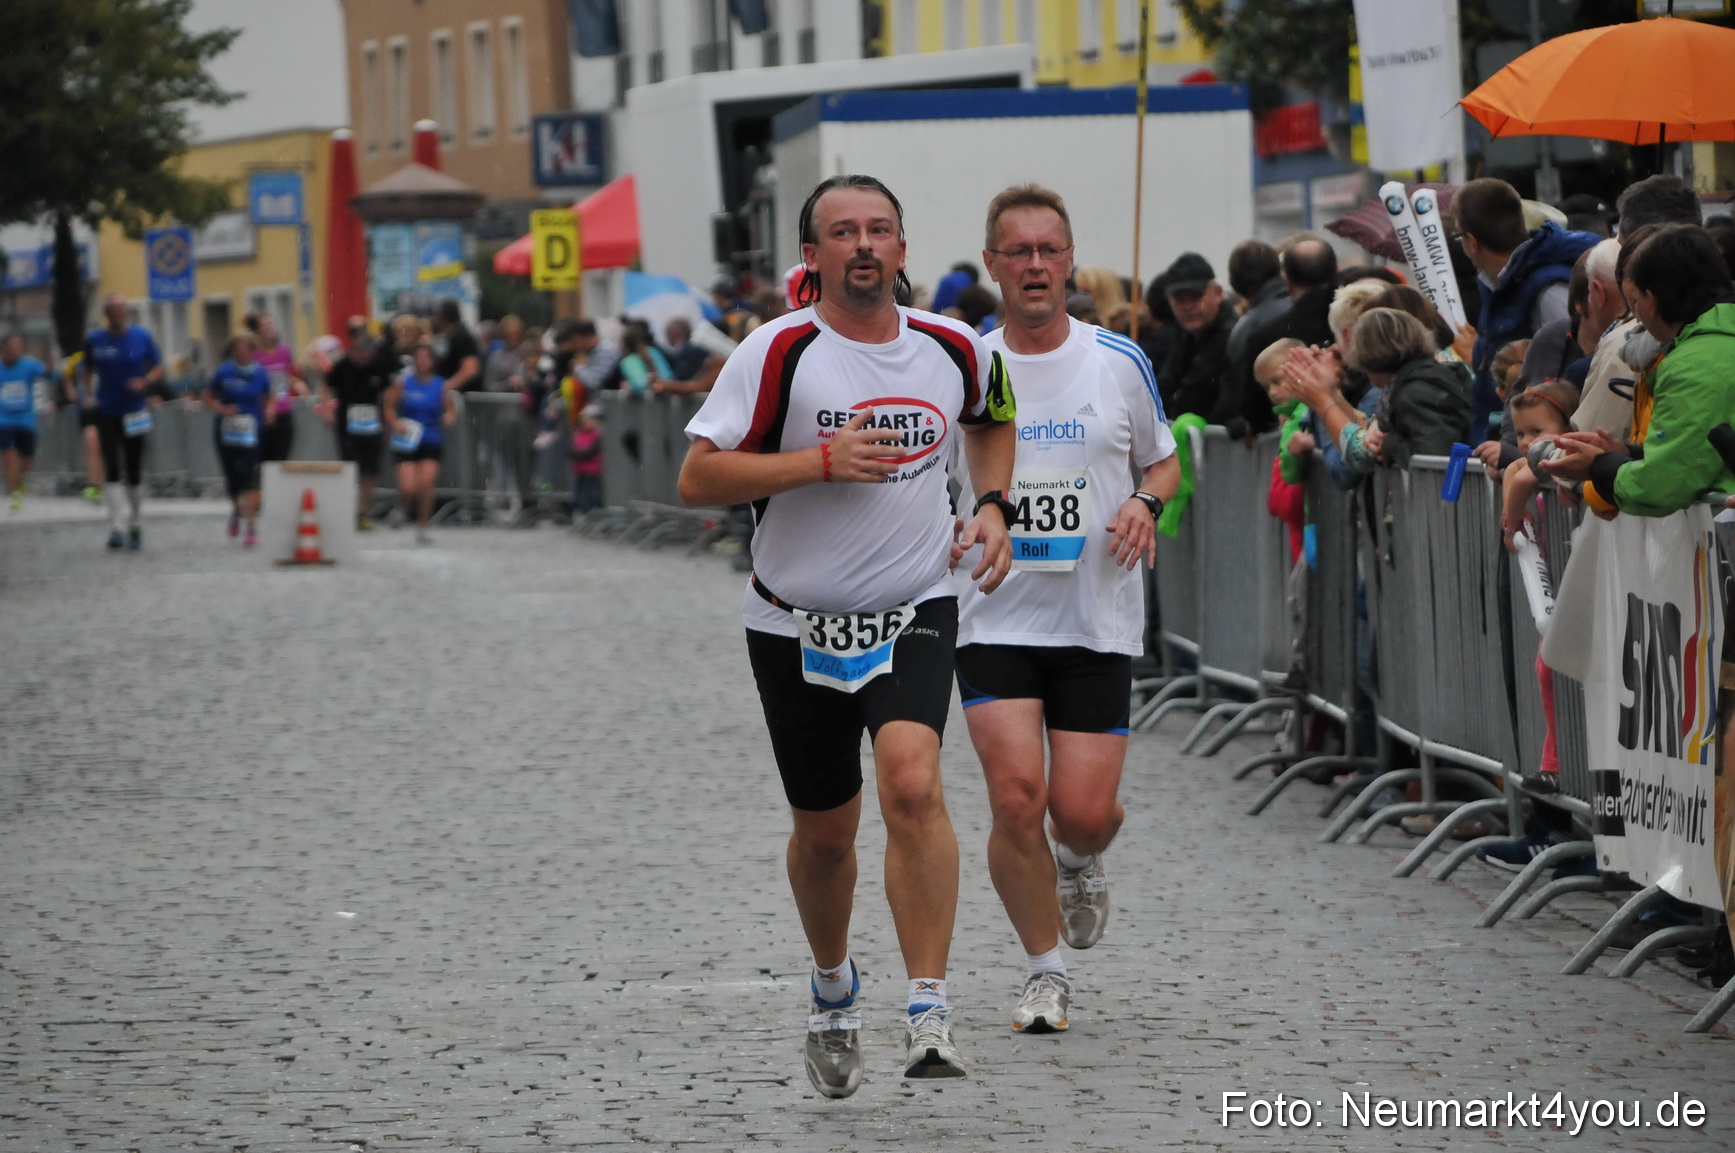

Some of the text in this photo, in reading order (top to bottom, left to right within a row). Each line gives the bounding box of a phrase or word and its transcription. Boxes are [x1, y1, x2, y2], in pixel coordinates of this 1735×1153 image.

[546, 234, 571, 271] D
[816, 409, 934, 430] GEHART &
[1018, 480, 1070, 490] Neumarkt
[1021, 542, 1049, 557] Rolf
[806, 610, 903, 651] 3356
[914, 626, 939, 637] asics
